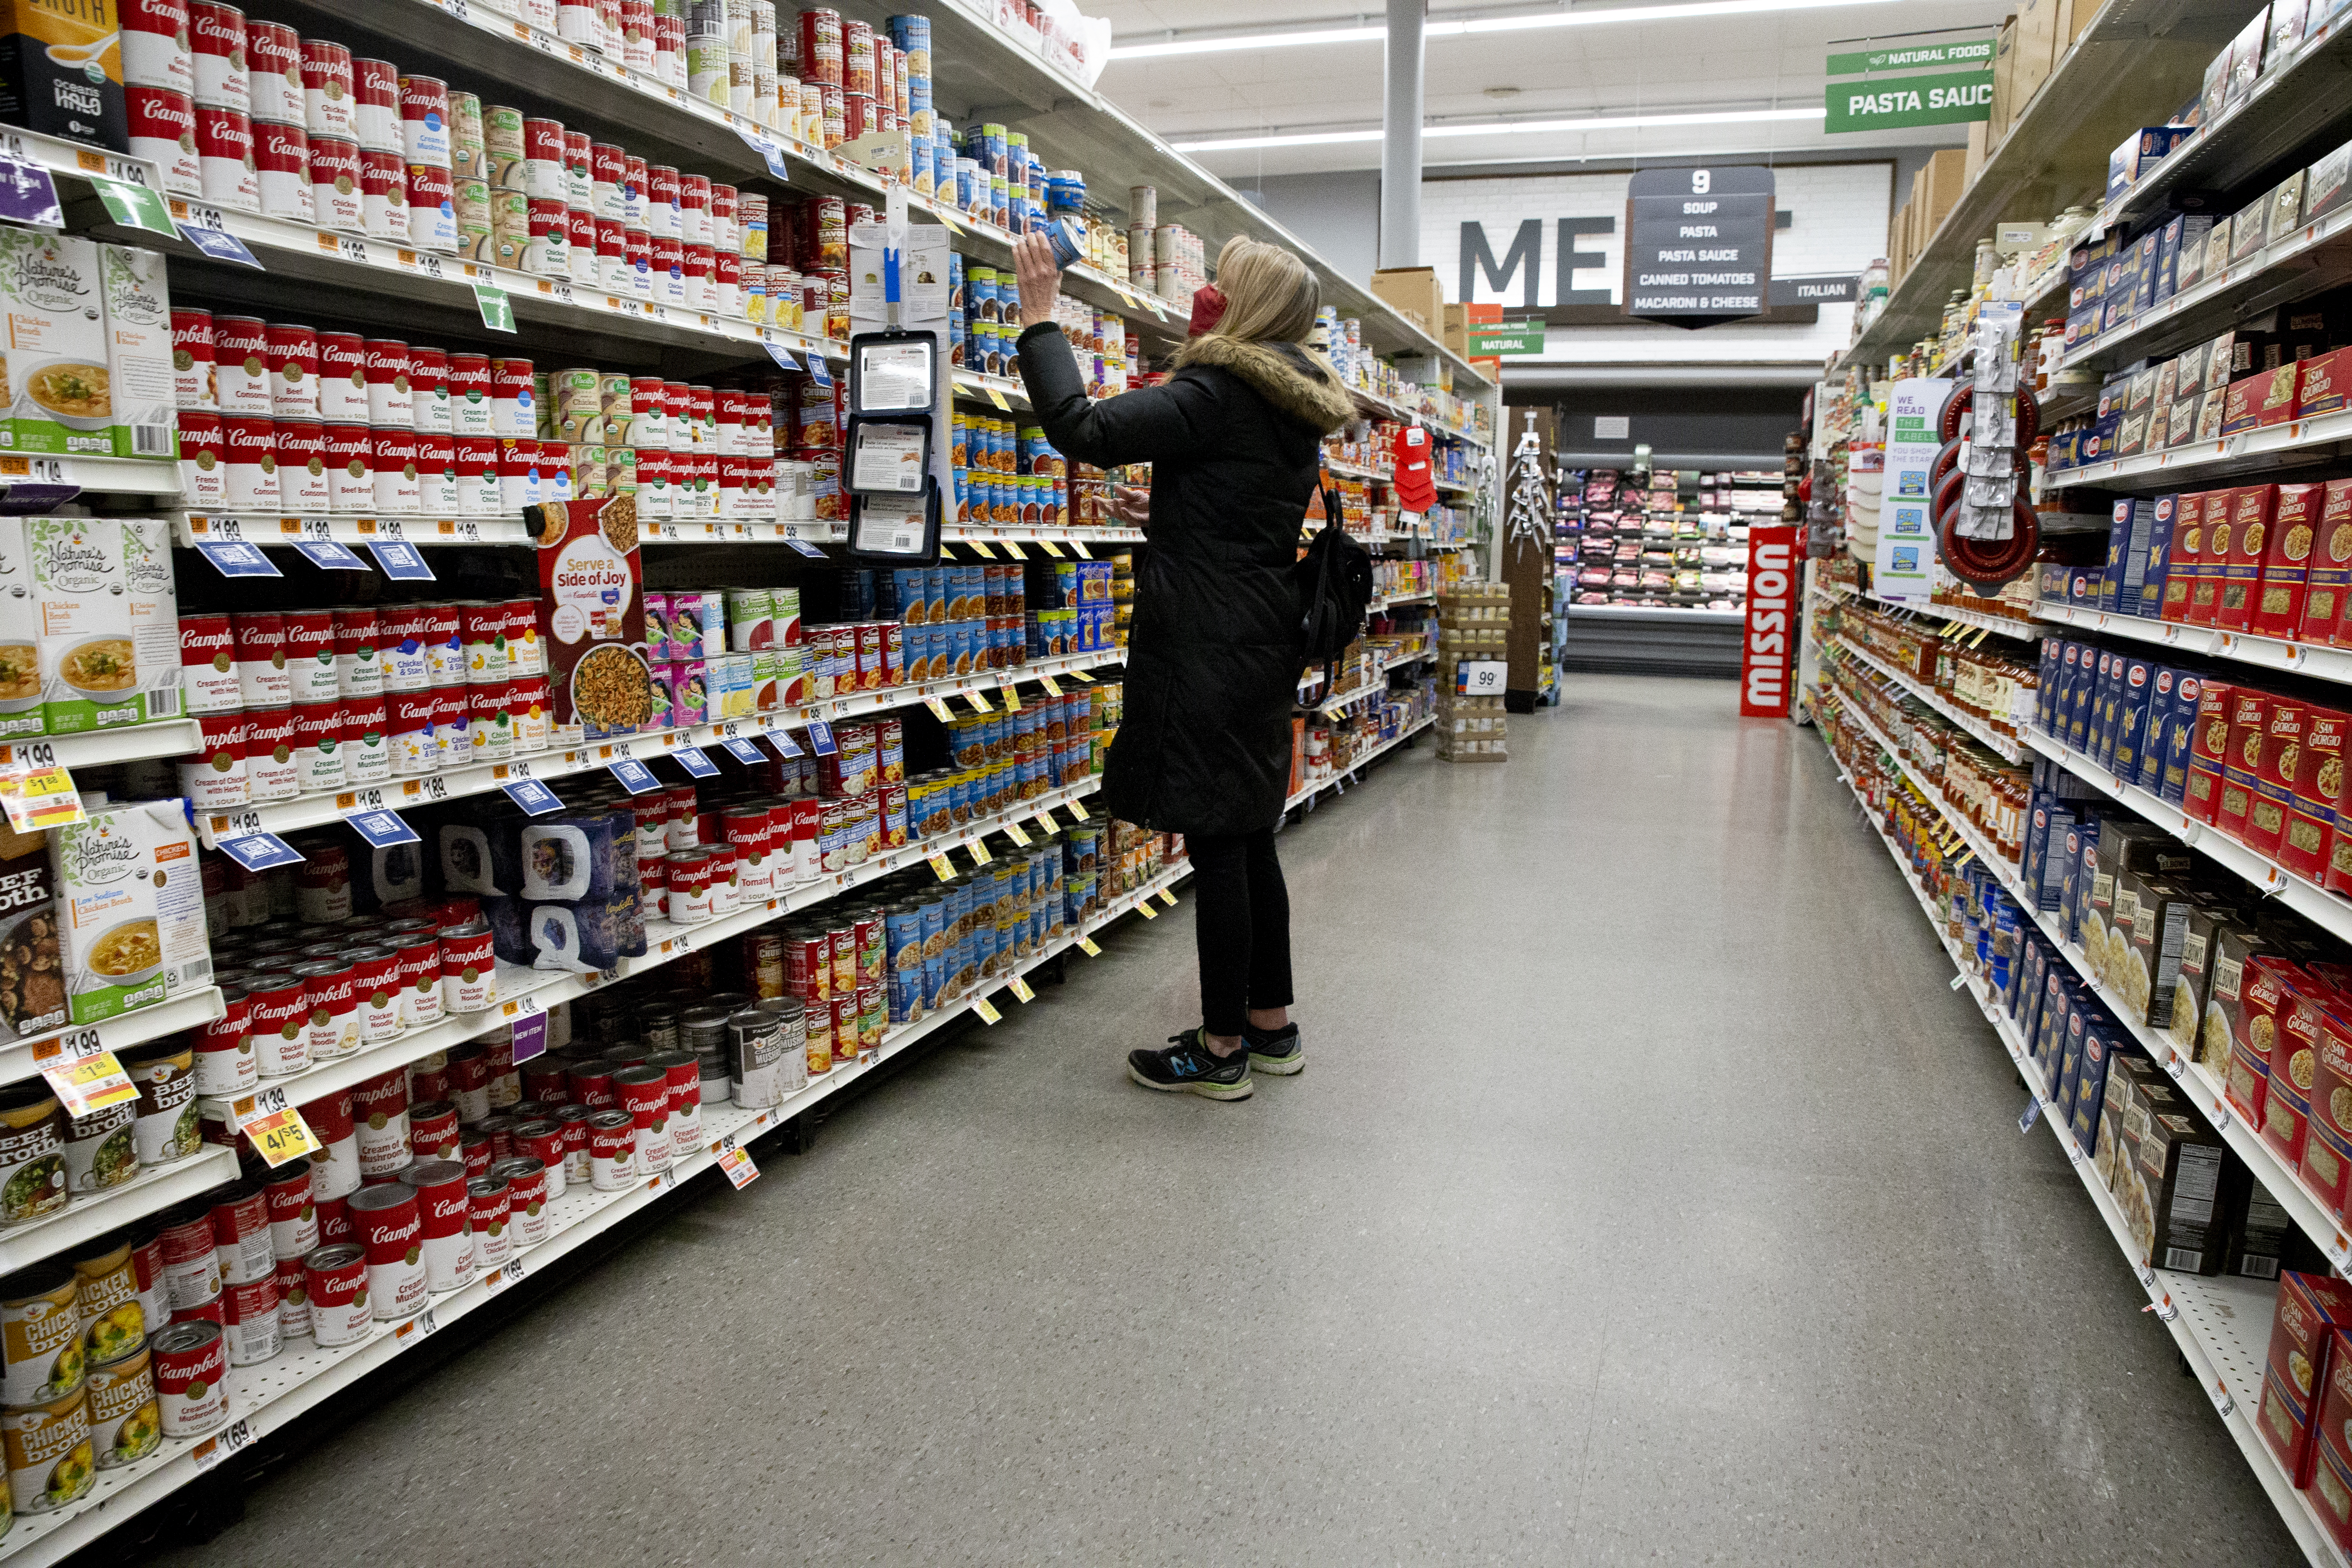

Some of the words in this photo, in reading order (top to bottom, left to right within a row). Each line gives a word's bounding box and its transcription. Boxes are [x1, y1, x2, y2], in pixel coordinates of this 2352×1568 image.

[1888, 49, 1945, 64] NATURAL
[1948, 44, 1990, 59] FOODS
[1849, 91, 1921, 115] PASTA
[1929, 84, 1993, 109] SAUC
[1692, 170, 1710, 194] 9
[1683, 201, 1718, 214] SOUP
[1680, 226, 1717, 237] PASTA
[1659, 250, 1696, 261] PASTA
[1699, 250, 1739, 260] SAUCE
[1640, 274, 1689, 285] CANNED
[1691, 273, 1755, 285] TOMATOES
[1798, 284, 1846, 297] ITALIAN
[1635, 297, 1697, 309] MACARONI
[1700, 297, 1709, 308] &
[1711, 297, 1758, 308] CHEESE
[1482, 340, 1524, 350] NATURAL
[1897, 396, 1914, 405] WE
[1896, 406, 1925, 415] READ
[1897, 417, 1921, 428] THE
[2286, 492, 2298, 505] SAN
[2278, 502, 2305, 521] GIORGIO
[567, 559, 604, 572] Serve
[607, 559, 615, 569] a
[558, 573, 586, 587] Side
[588, 572, 601, 585] of
[603, 572, 626, 587] Joy
[2244, 700, 2257, 712] SAN
[2237, 710, 2261, 723] GIORGIO
[2279, 709, 2294, 723] SAN
[2271, 720, 2300, 734] GIORGIO
[2318, 721, 2334, 735] SAN
[2308, 731, 2341, 747] GIORGIO
[741, 877, 770, 887] Tomato
